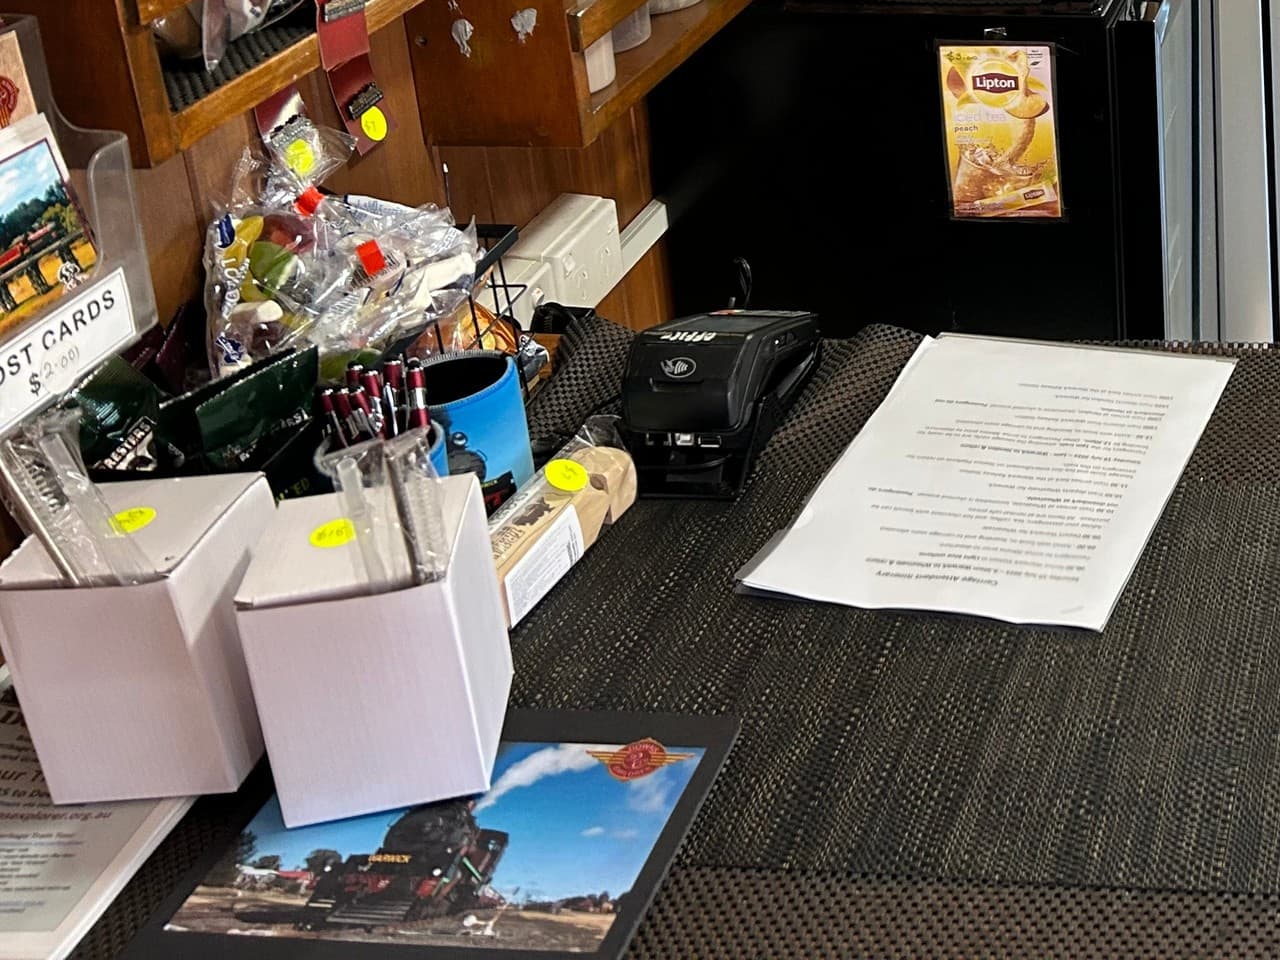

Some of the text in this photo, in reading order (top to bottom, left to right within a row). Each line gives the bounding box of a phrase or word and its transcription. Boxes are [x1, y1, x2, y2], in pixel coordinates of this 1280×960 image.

[975, 76, 1016, 90] Lipton
[954, 124, 979, 133] peach
[42, 290, 115, 351] CARDS
